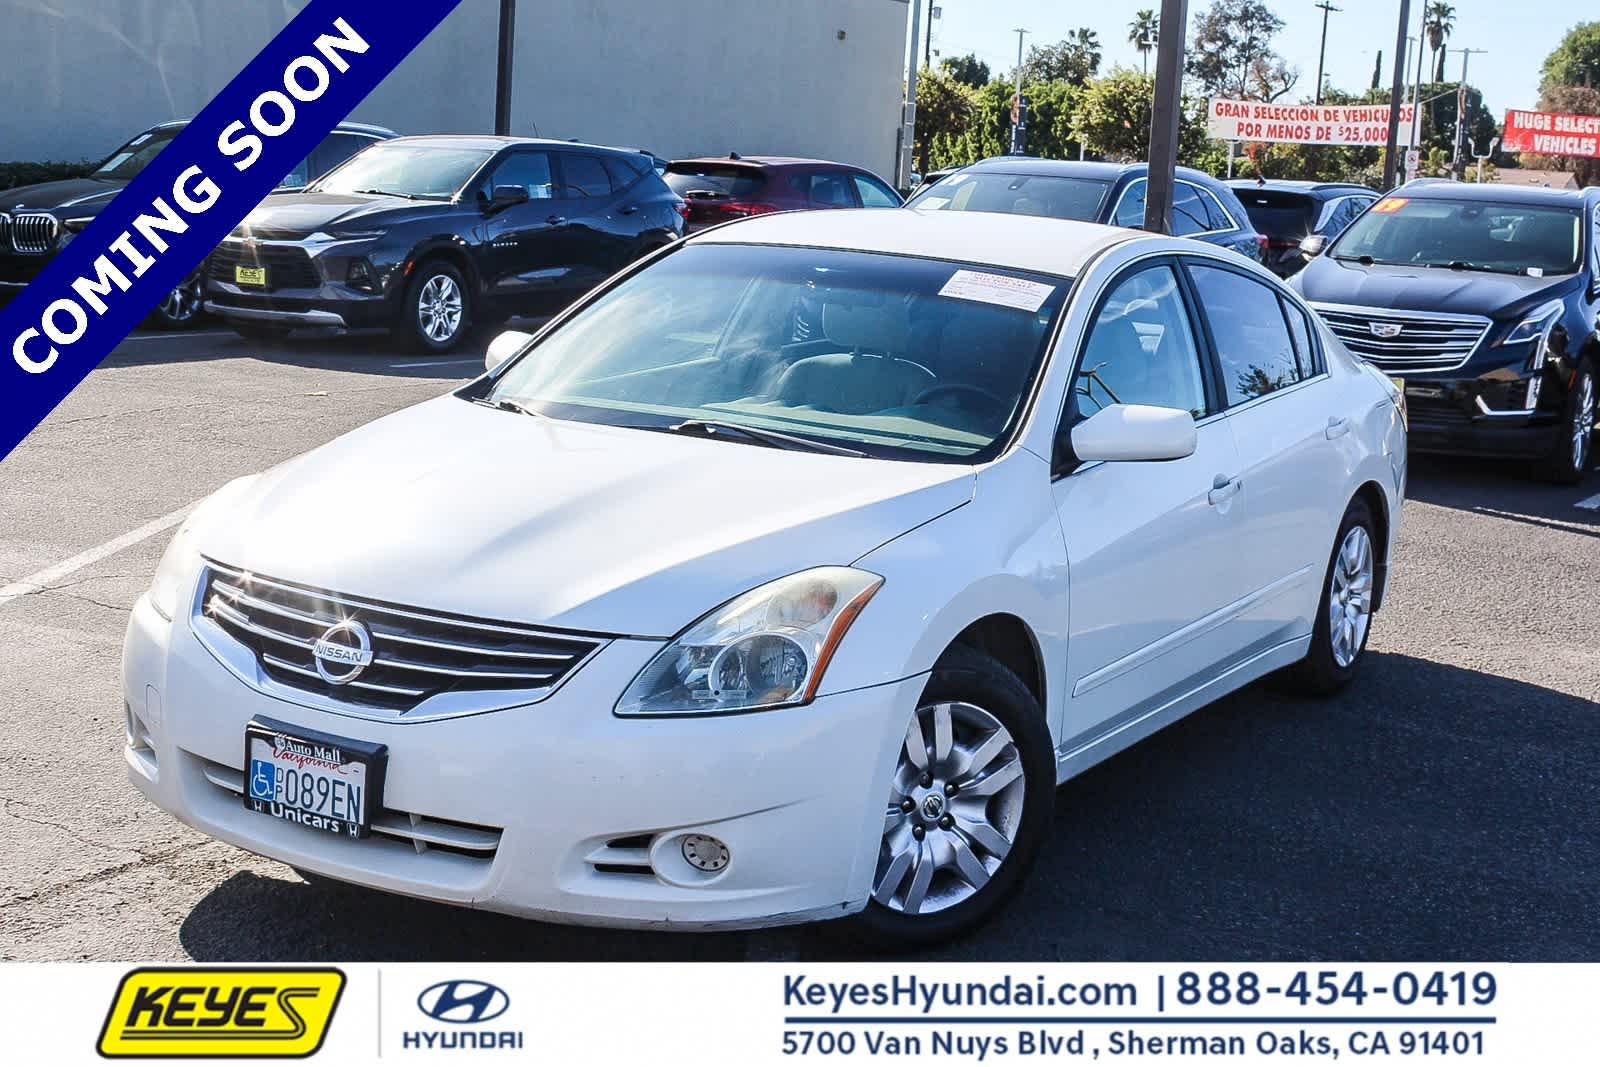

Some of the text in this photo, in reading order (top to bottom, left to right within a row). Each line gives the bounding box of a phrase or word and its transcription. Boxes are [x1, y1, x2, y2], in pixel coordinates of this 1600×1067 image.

[1215, 102, 1249, 118] GRAN
[1324, 109, 1339, 121] DE
[1343, 107, 1413, 122] VEHICUOS
[1513, 111, 1552, 130] HUGE
[1237, 122, 1388, 142] POR MENOS DE $25,000
[1533, 134, 1597, 155] VEHICLES
[315, 644, 363, 662] NISSAN
[286, 740, 341, 762] Auto Mall
[285, 769, 361, 824] 089EN
[270, 801, 340, 832] Unicars
